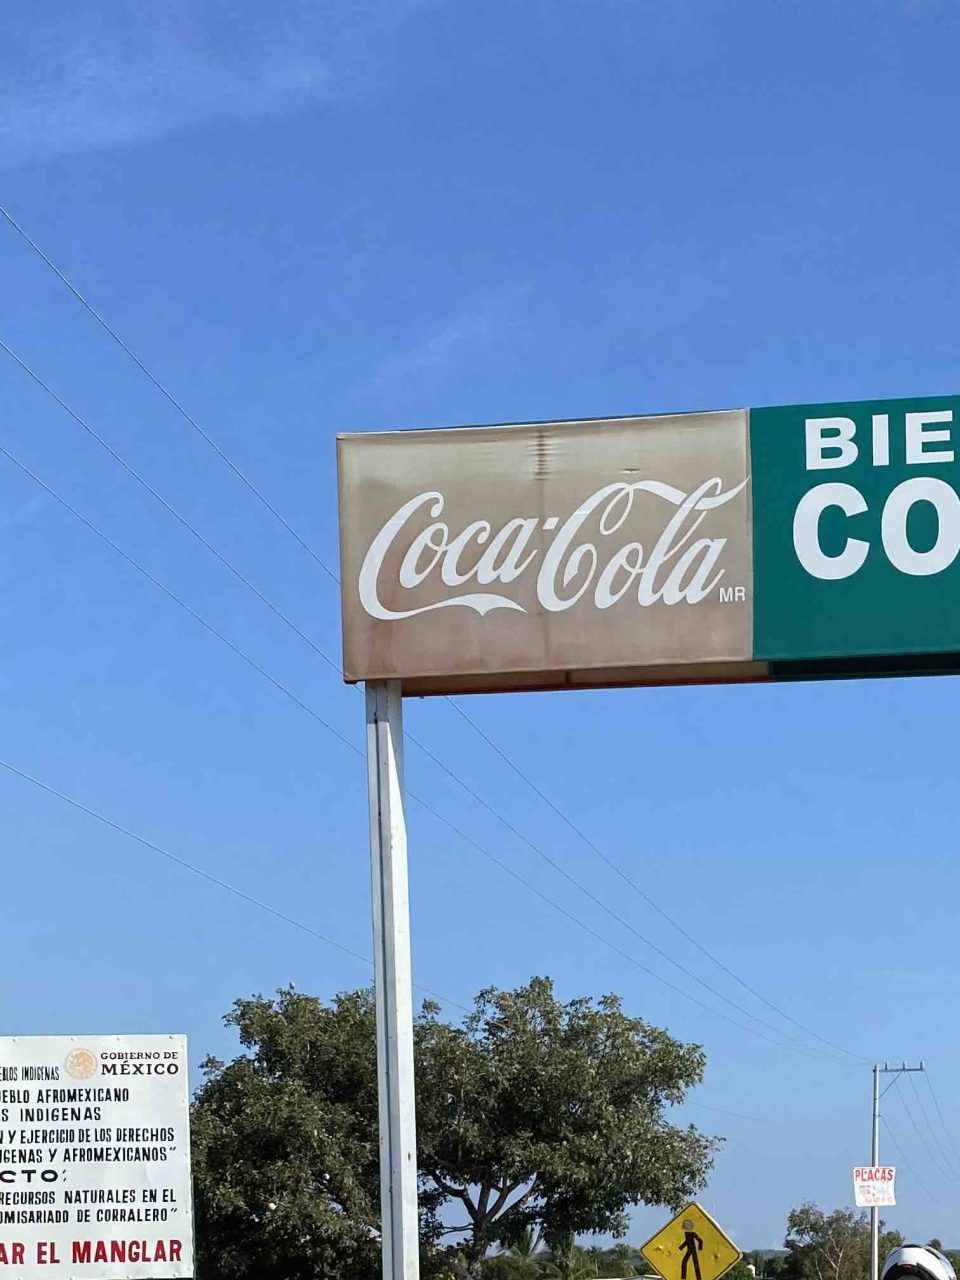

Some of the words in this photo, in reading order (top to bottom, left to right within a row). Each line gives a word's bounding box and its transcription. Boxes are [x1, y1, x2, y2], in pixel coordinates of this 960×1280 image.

[358, 476, 751, 620] Coca-Cola
[720, 586, 746, 602] MR
[100, 1051, 160, 1060] GOBIERNO
[163, 1051, 179, 1060] DE
[21, 1066, 60, 1081] INDIGENAS
[101, 1060, 179, 1076] MÉXICO
[0, 1089, 30, 1104] EBLO
[37, 1087, 130, 1104] AFROMEXICANO
[20, 1106, 102, 1122] INDIGENAS
[8, 1130, 17, 1144] Y
[20, 1129, 75, 1144] EJERCICIO
[78, 1128, 91, 1143] DE
[94, 1127, 112, 1143] LOS
[116, 1126, 175, 1143] DERECHOS
[48, 1148, 58, 1162] Y
[855, 1168, 894, 1182] PLACAS
[64, 1189, 136, 1204] NATURALES
[142, 1188, 157, 1203] EN
[162, 1188, 177, 1203] EL
[77, 1209, 91, 1223] DE
[37, 1241, 61, 1265] EL
[72, 1239, 182, 1264] MANGLAR
